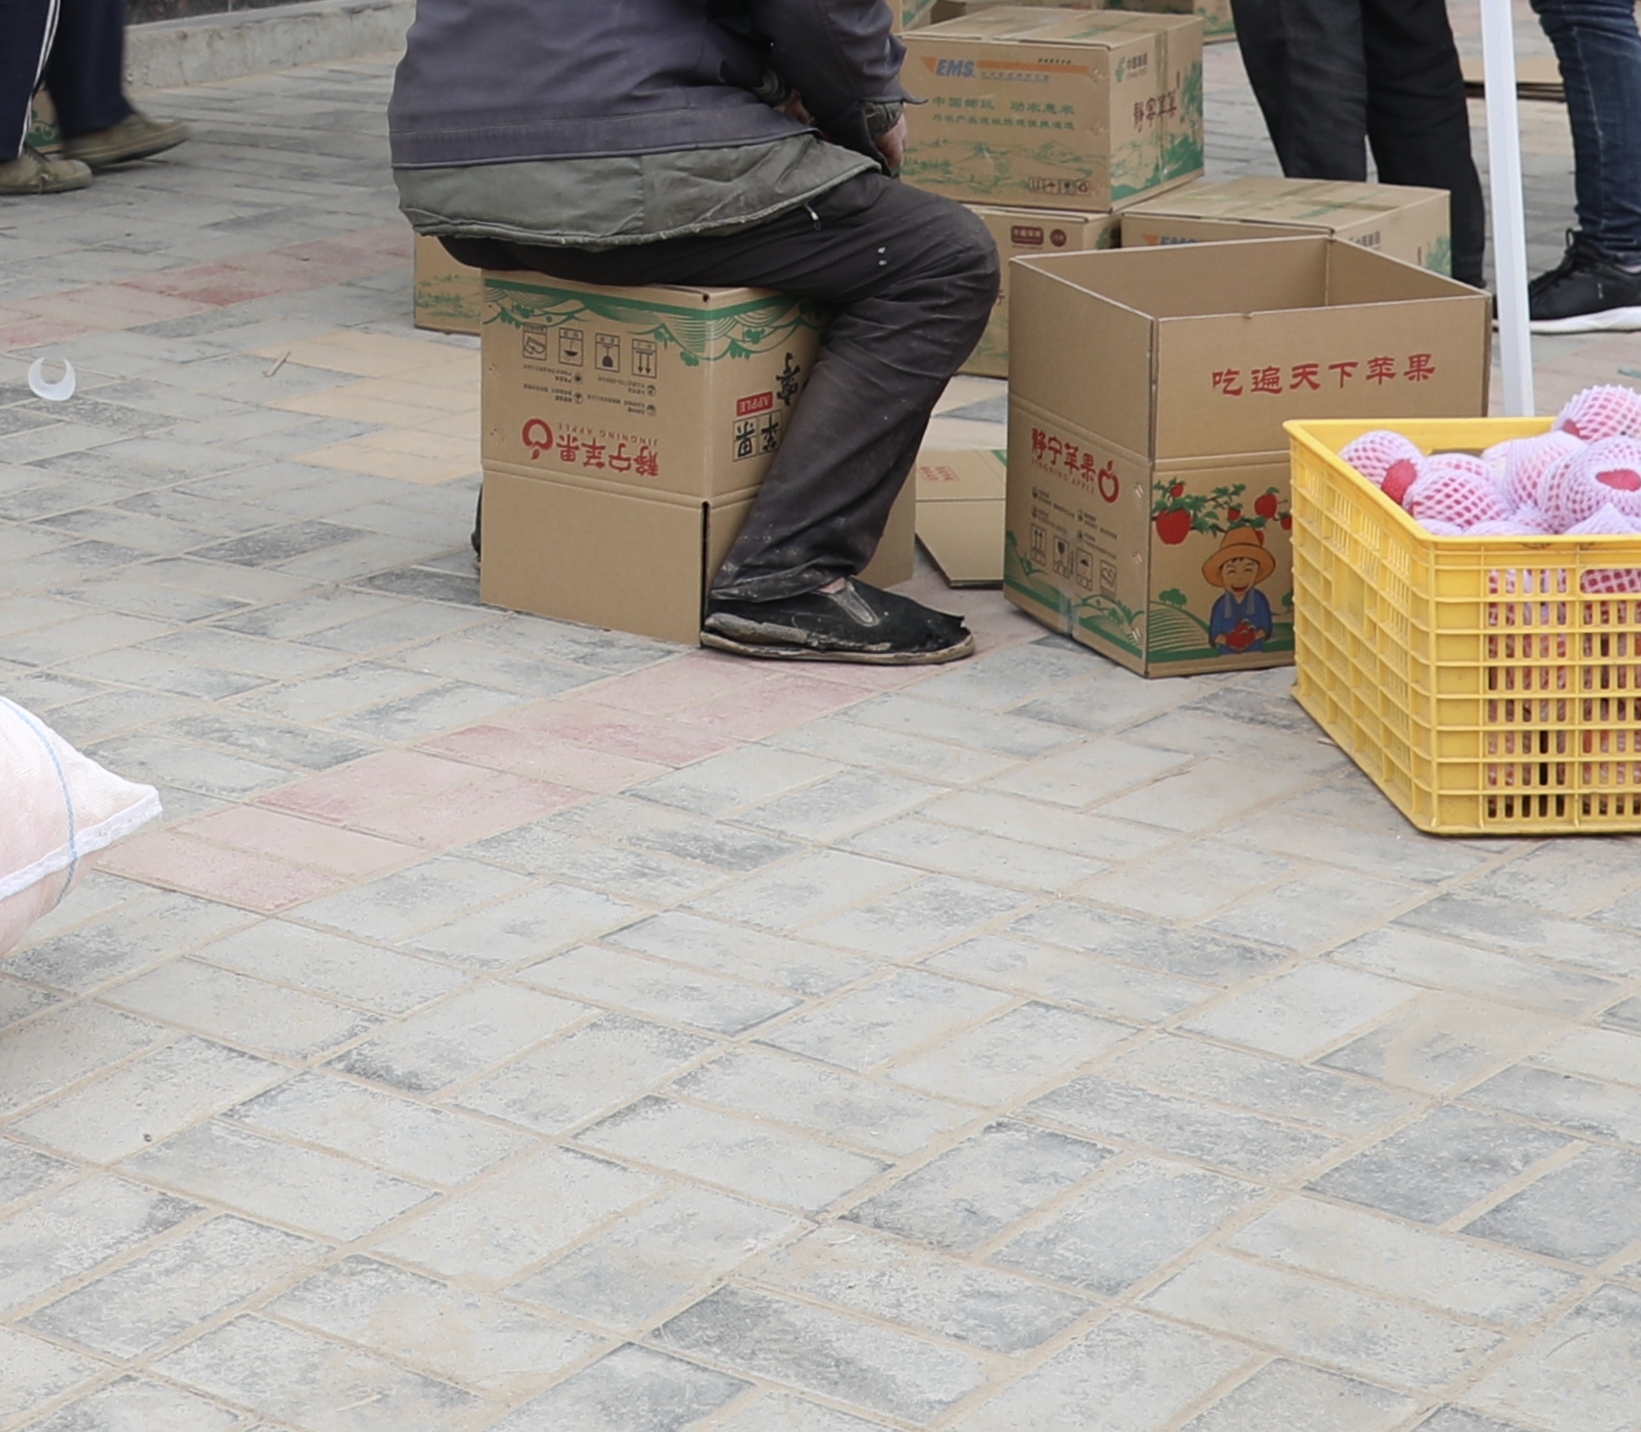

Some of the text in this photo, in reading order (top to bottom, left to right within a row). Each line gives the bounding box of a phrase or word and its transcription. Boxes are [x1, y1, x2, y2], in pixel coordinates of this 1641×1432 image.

[1211, 353, 1437, 397] 吃遍天下苹果
[739, 393, 773, 414] APPLE
[555, 432, 660, 477] 静宁苹果
[1030, 427, 1097, 484] 静宁苹果
